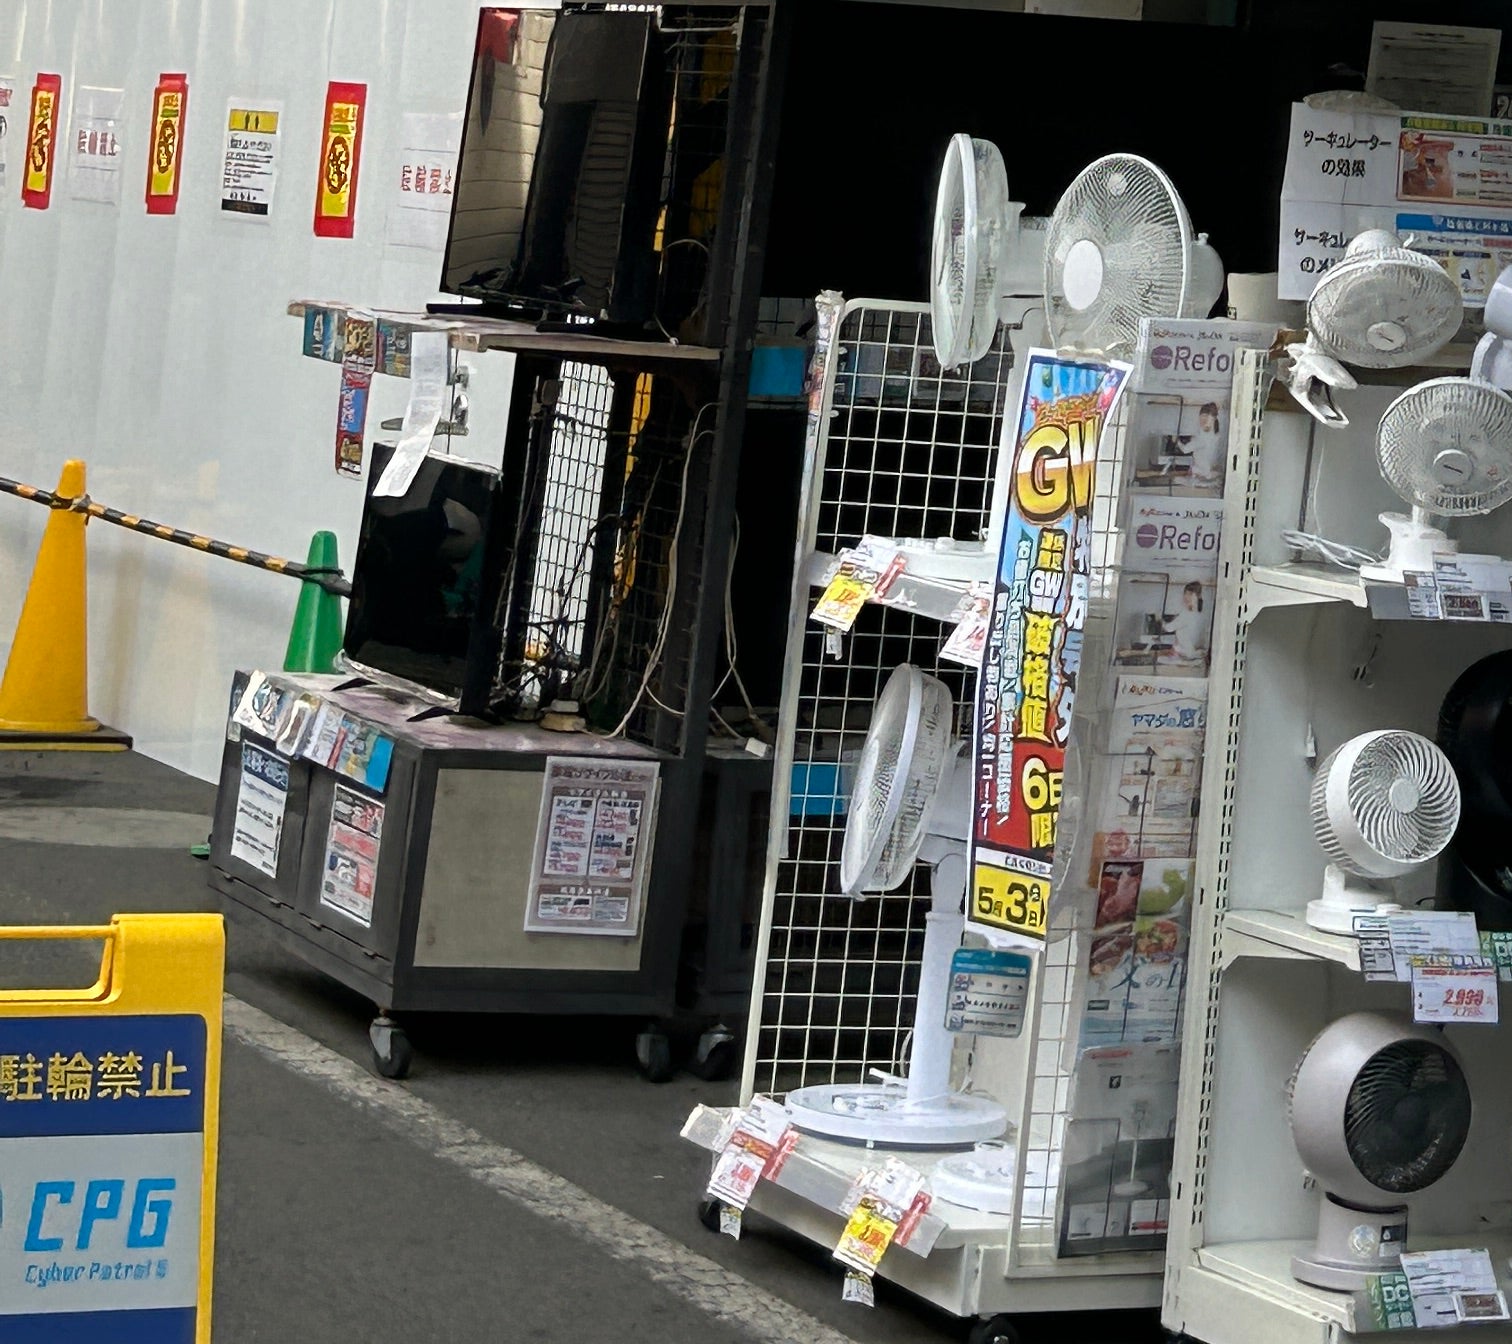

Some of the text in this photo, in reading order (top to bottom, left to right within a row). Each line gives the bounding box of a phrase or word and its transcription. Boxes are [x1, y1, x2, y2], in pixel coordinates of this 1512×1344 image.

[1303, 130, 1392, 150] サーキュレーター
[0, 1050, 191, 1101] 駐輪禁止
[24, 1178, 177, 1252] CPG
